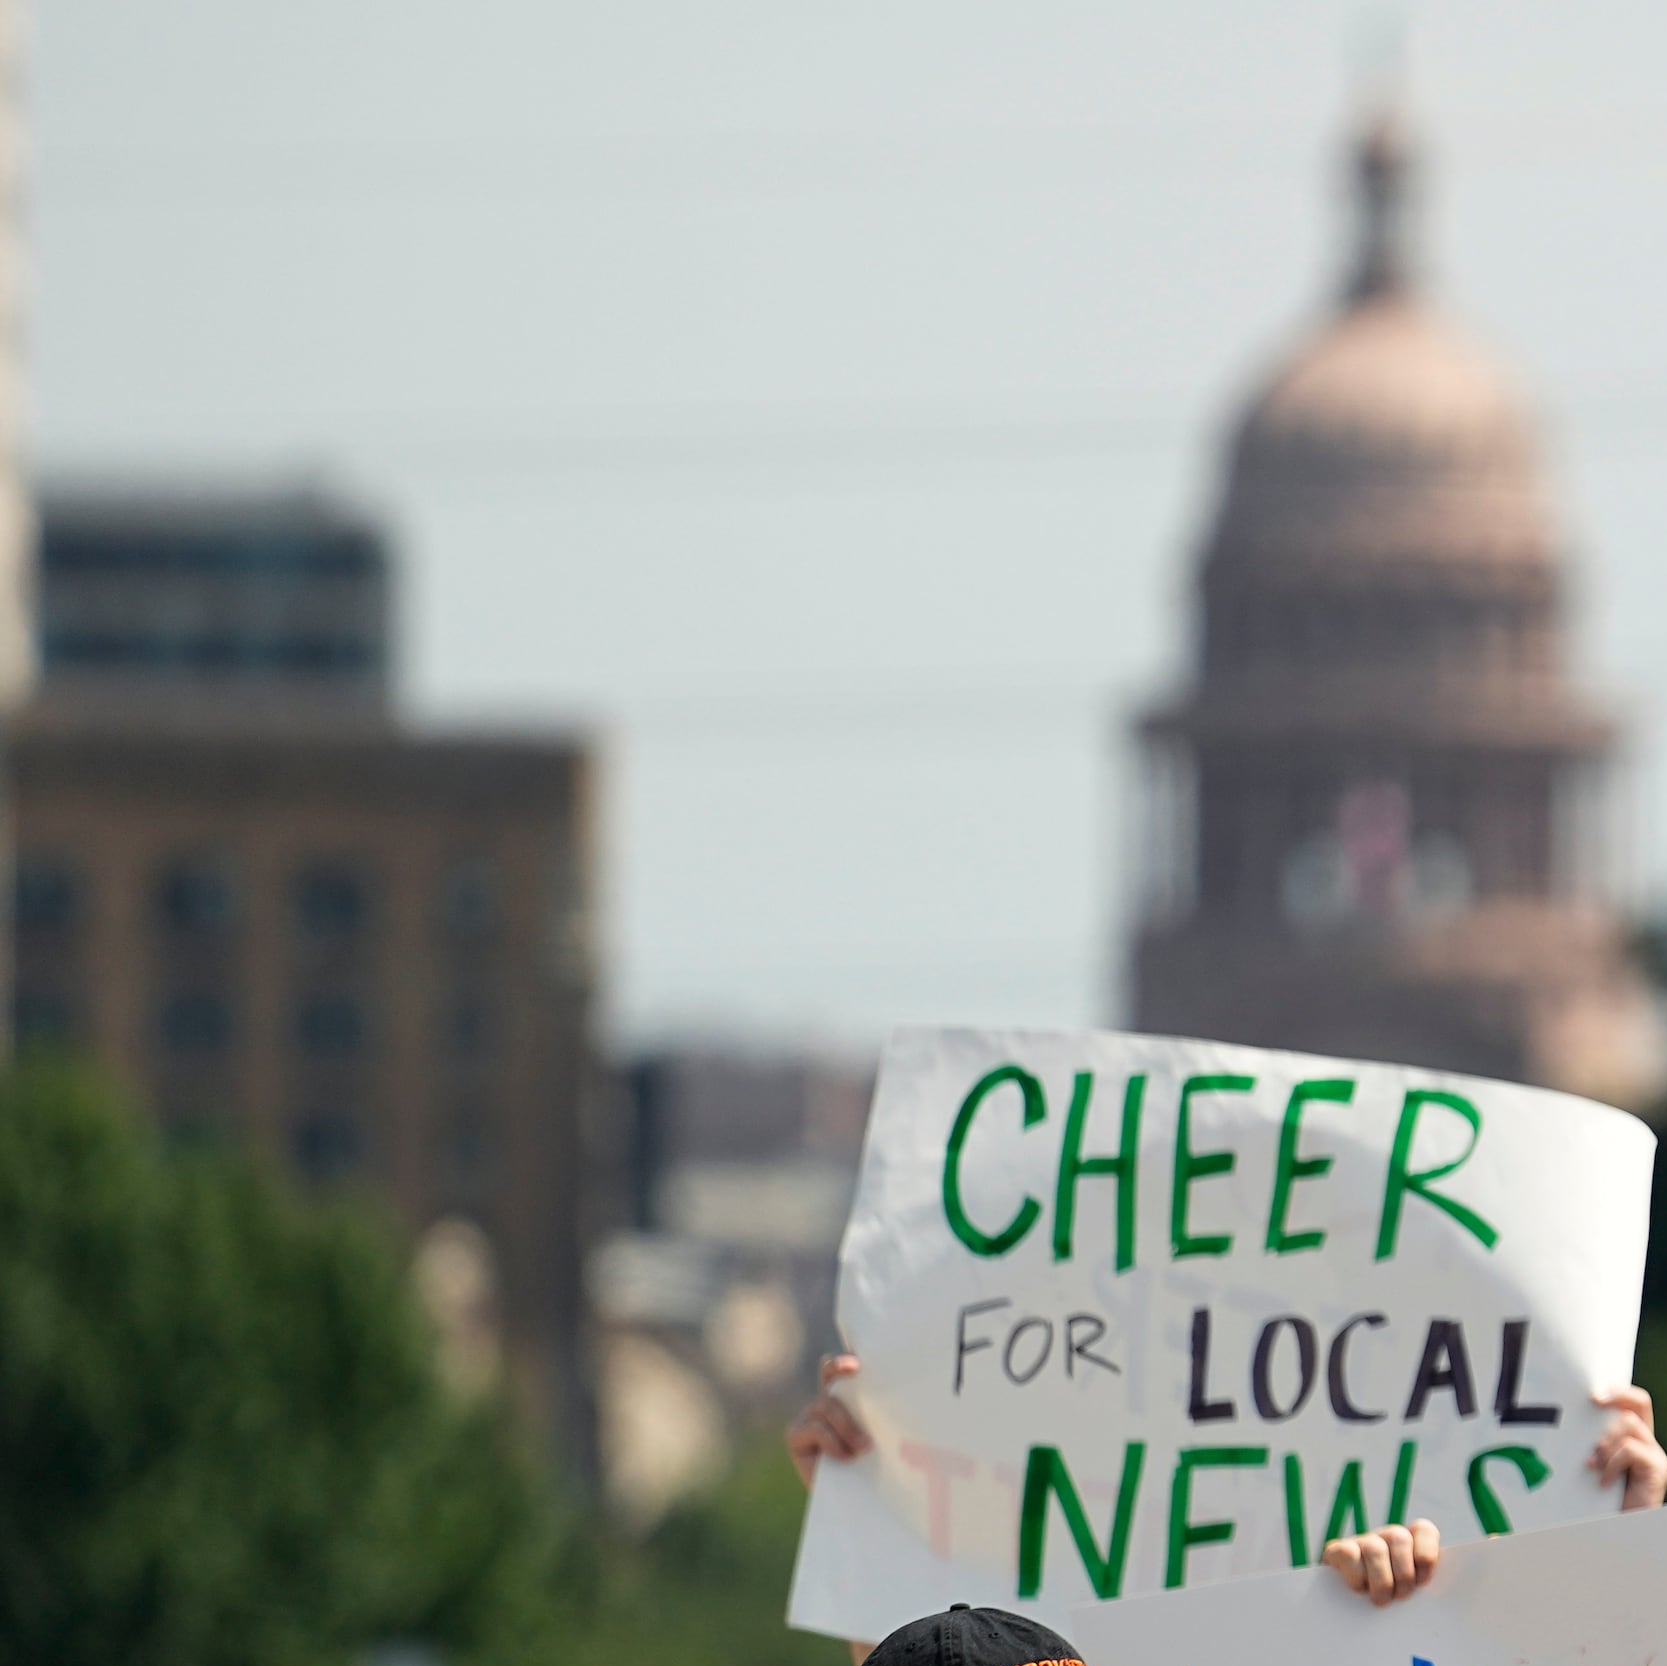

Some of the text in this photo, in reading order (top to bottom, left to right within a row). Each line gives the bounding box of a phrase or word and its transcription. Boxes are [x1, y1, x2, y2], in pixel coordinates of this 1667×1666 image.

[942, 1064, 1499, 1274] CHEER
[953, 1297, 1561, 1426] FOR LOCAL
